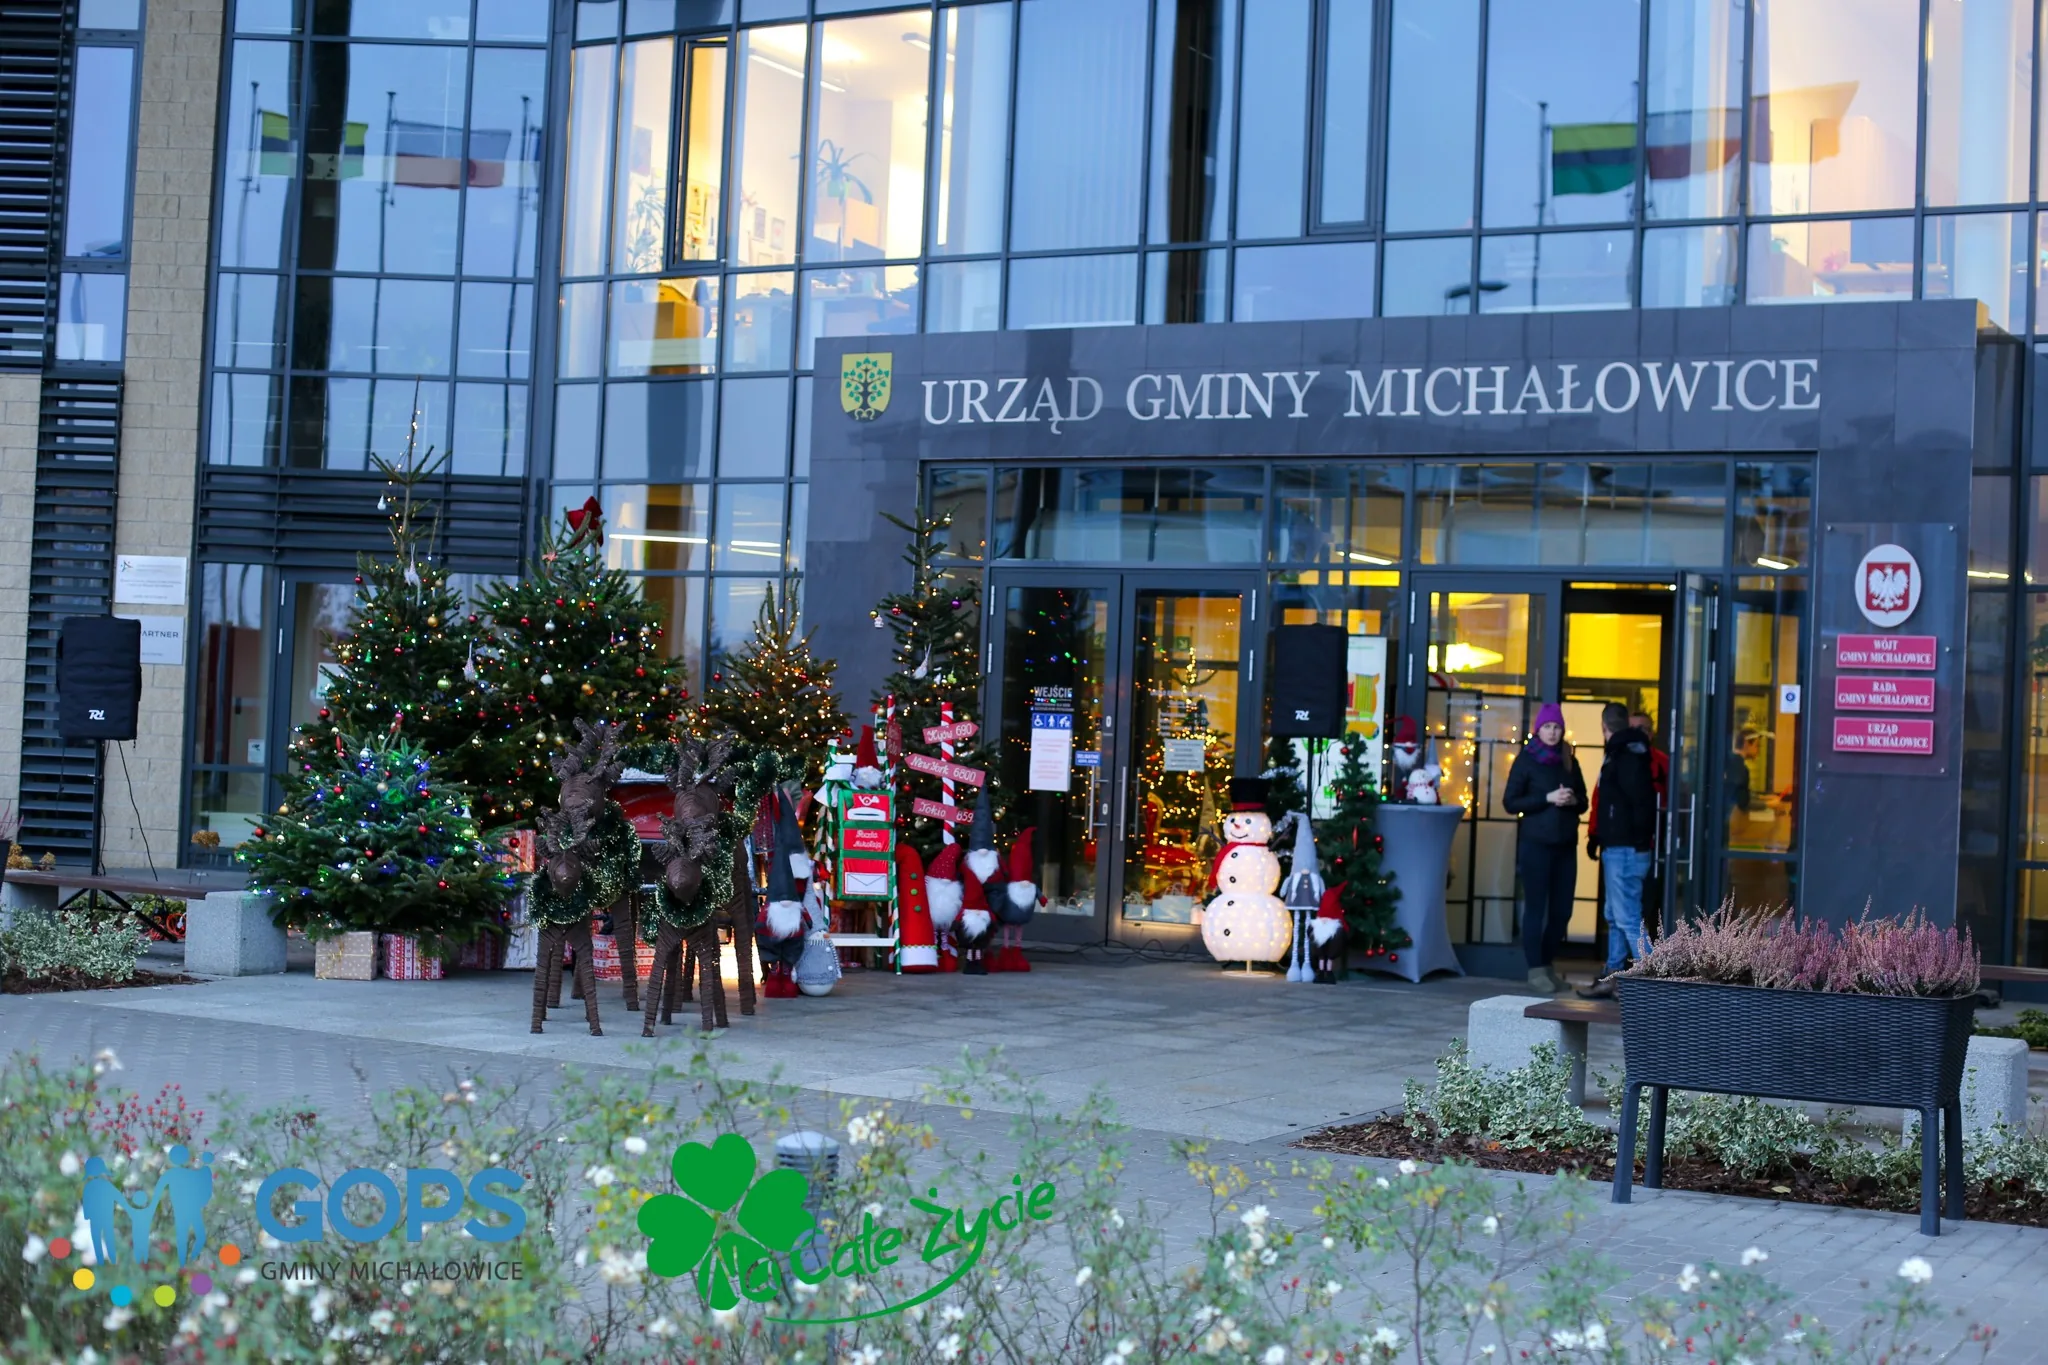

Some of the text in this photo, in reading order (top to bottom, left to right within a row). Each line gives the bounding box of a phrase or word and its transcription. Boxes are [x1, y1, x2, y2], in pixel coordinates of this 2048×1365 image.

[922, 358, 1821, 434] URZĄD GMINY MICHAŁOWICE
[142, 630, 179, 639] ARTNER
[1873, 637, 1898, 651] WÓJT
[1840, 651, 1868, 663] GMINY
[1033, 685, 1073, 698] WEJŚCIE
[1872, 681, 1897, 693] RADA
[1838, 693, 1866, 705] GMINY
[955, 722, 973, 736] 690
[1867, 723, 1899, 736] URZĄD
[1837, 734, 1865, 746] GMINY
[953, 767, 977, 782] 6800
[918, 802, 974, 823] Tokio 859
